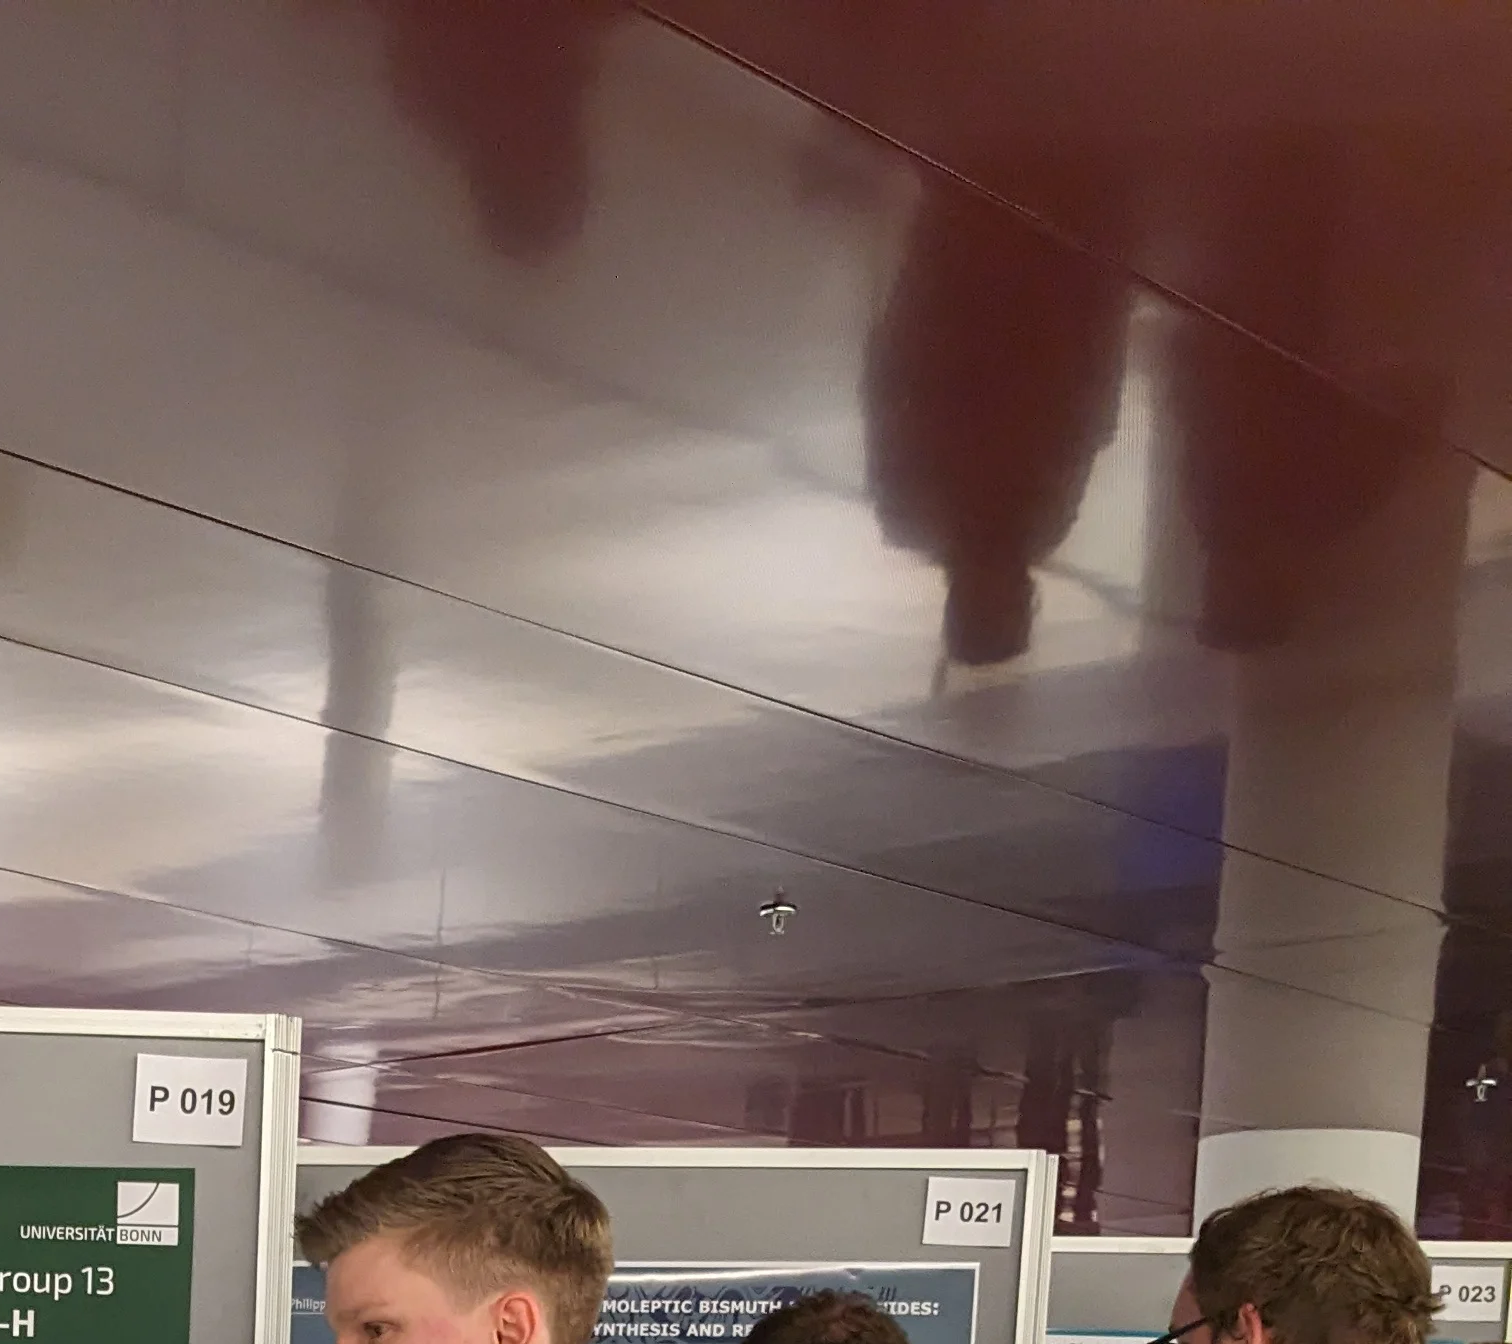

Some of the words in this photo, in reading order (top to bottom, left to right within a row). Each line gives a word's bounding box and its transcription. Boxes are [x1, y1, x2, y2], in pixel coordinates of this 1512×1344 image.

[150, 1085, 170, 1112] P
[180, 1087, 236, 1116] 019
[934, 1200, 952, 1221] P
[959, 1201, 1003, 1223] 021
[20, 1224, 115, 1242] UNIVERSITÄT
[119, 1228, 163, 1243] BONN
[81, 1266, 116, 1296] 13
[1458, 1285, 1496, 1303] 023
[602, 1299, 693, 1314] MOLEPTIC
[593, 1322, 681, 1337] YNTHESIS
[686, 1323, 725, 1337] AND
